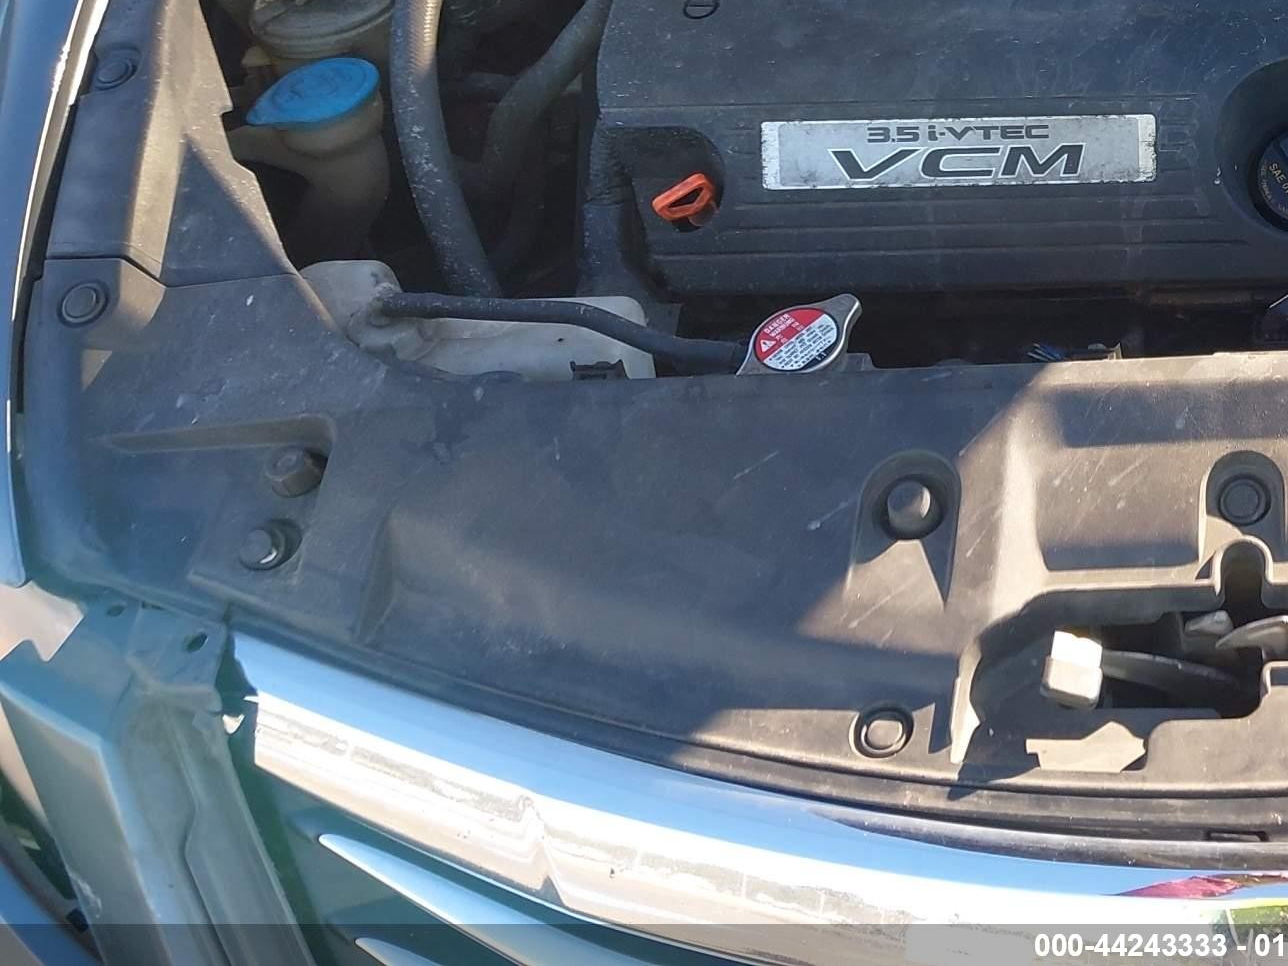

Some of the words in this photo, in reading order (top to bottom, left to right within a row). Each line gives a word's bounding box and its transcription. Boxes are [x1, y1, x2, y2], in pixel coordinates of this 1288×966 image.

[867, 126, 920, 143] 3.5
[928, 124, 1049, 142] i-VTEC
[827, 143, 1086, 180] VCM
[1269, 163, 1286, 183] SAE
[763, 313, 791, 335] DANGER
